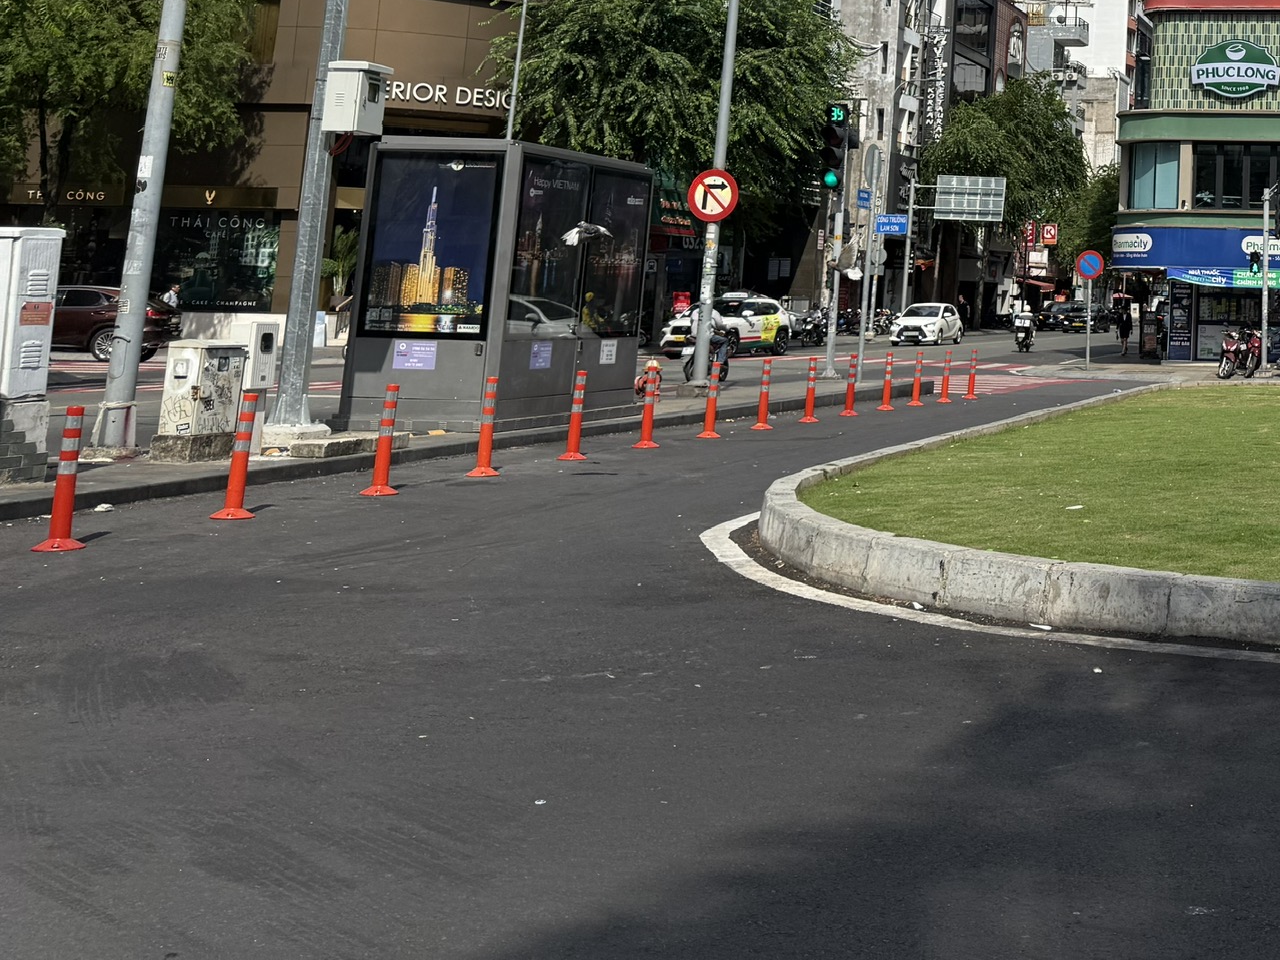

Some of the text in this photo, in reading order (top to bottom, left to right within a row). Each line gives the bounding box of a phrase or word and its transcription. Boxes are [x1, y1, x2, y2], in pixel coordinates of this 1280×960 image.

[926, 87, 935, 125] KOREAN
[534, 176, 581, 191] Happy VIETNAM
[66, 190, 105, 201] CÔNG
[170, 214, 265, 229] THÁI CÔNG
[1045, 228, 1052, 236] K
